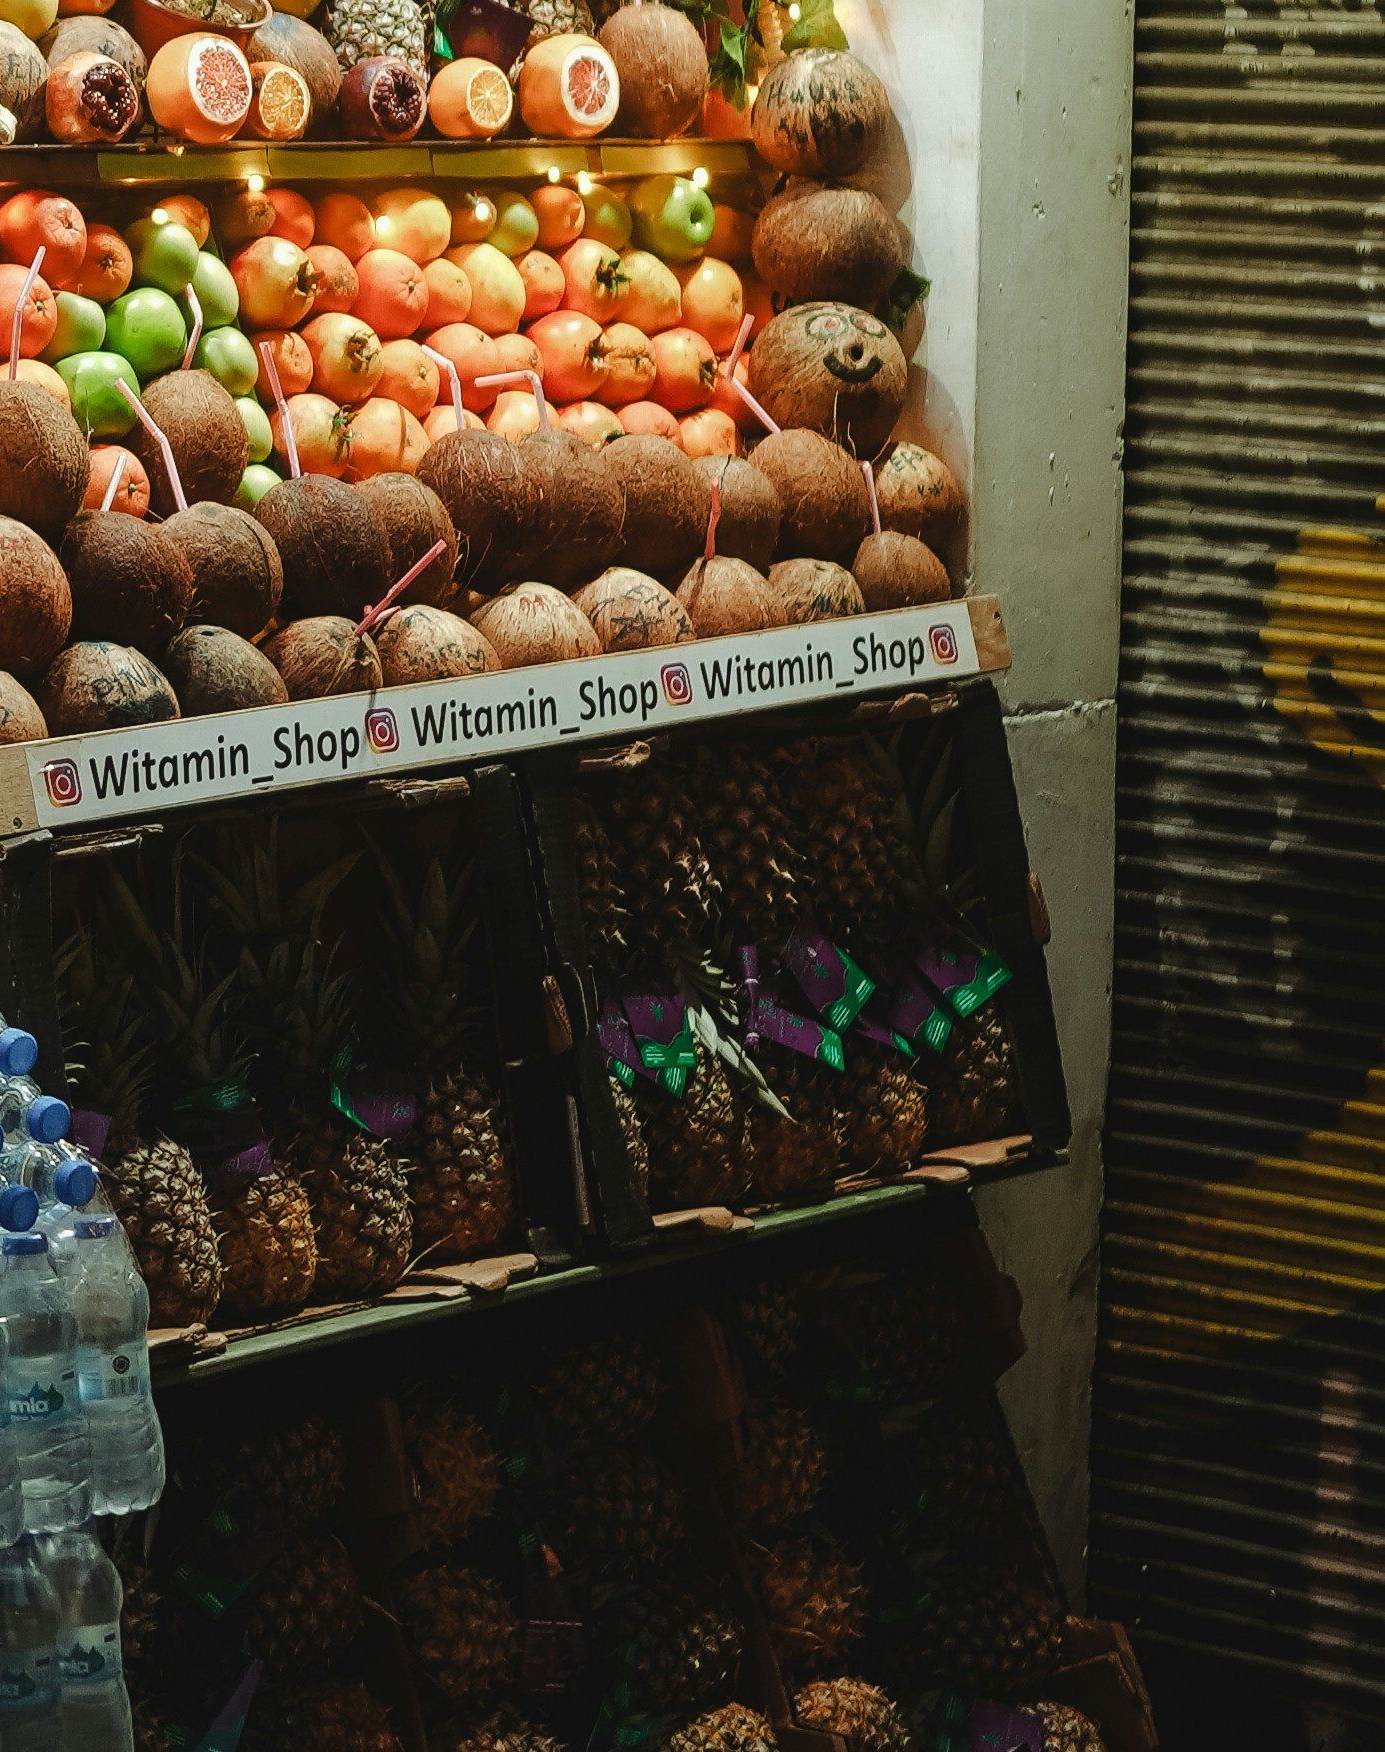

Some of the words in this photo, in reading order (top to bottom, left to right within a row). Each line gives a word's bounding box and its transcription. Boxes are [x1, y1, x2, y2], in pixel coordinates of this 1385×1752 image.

[700, 628, 927, 703] Witamin_Shop
[412, 673, 659, 748] Witamin_Shop
[89, 719, 362, 801] Witamin_Shop
